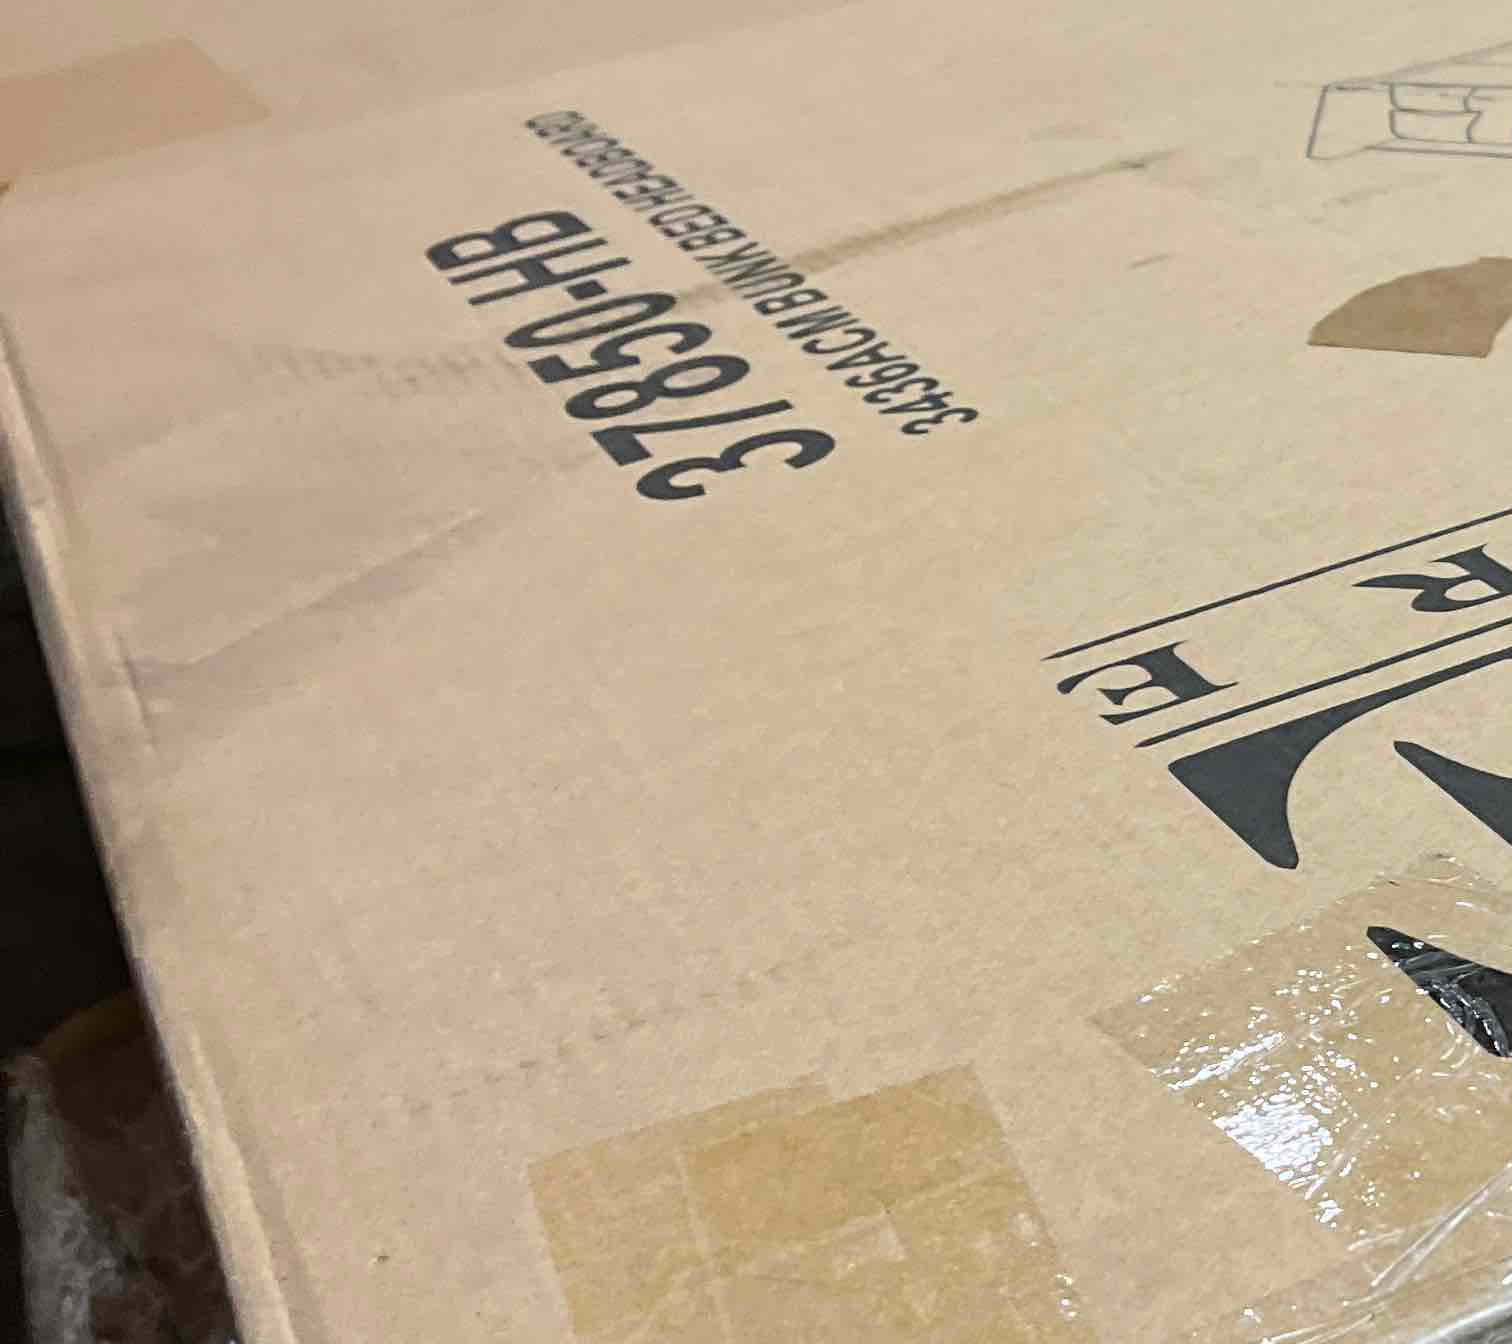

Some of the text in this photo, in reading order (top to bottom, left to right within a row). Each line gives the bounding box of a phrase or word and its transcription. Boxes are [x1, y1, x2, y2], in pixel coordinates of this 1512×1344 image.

[647, 202, 750, 252] BED
[693, 240, 828, 316] BUNK
[424, 209, 836, 501] 37850-HB
[776, 300, 979, 436] 3436ACM
